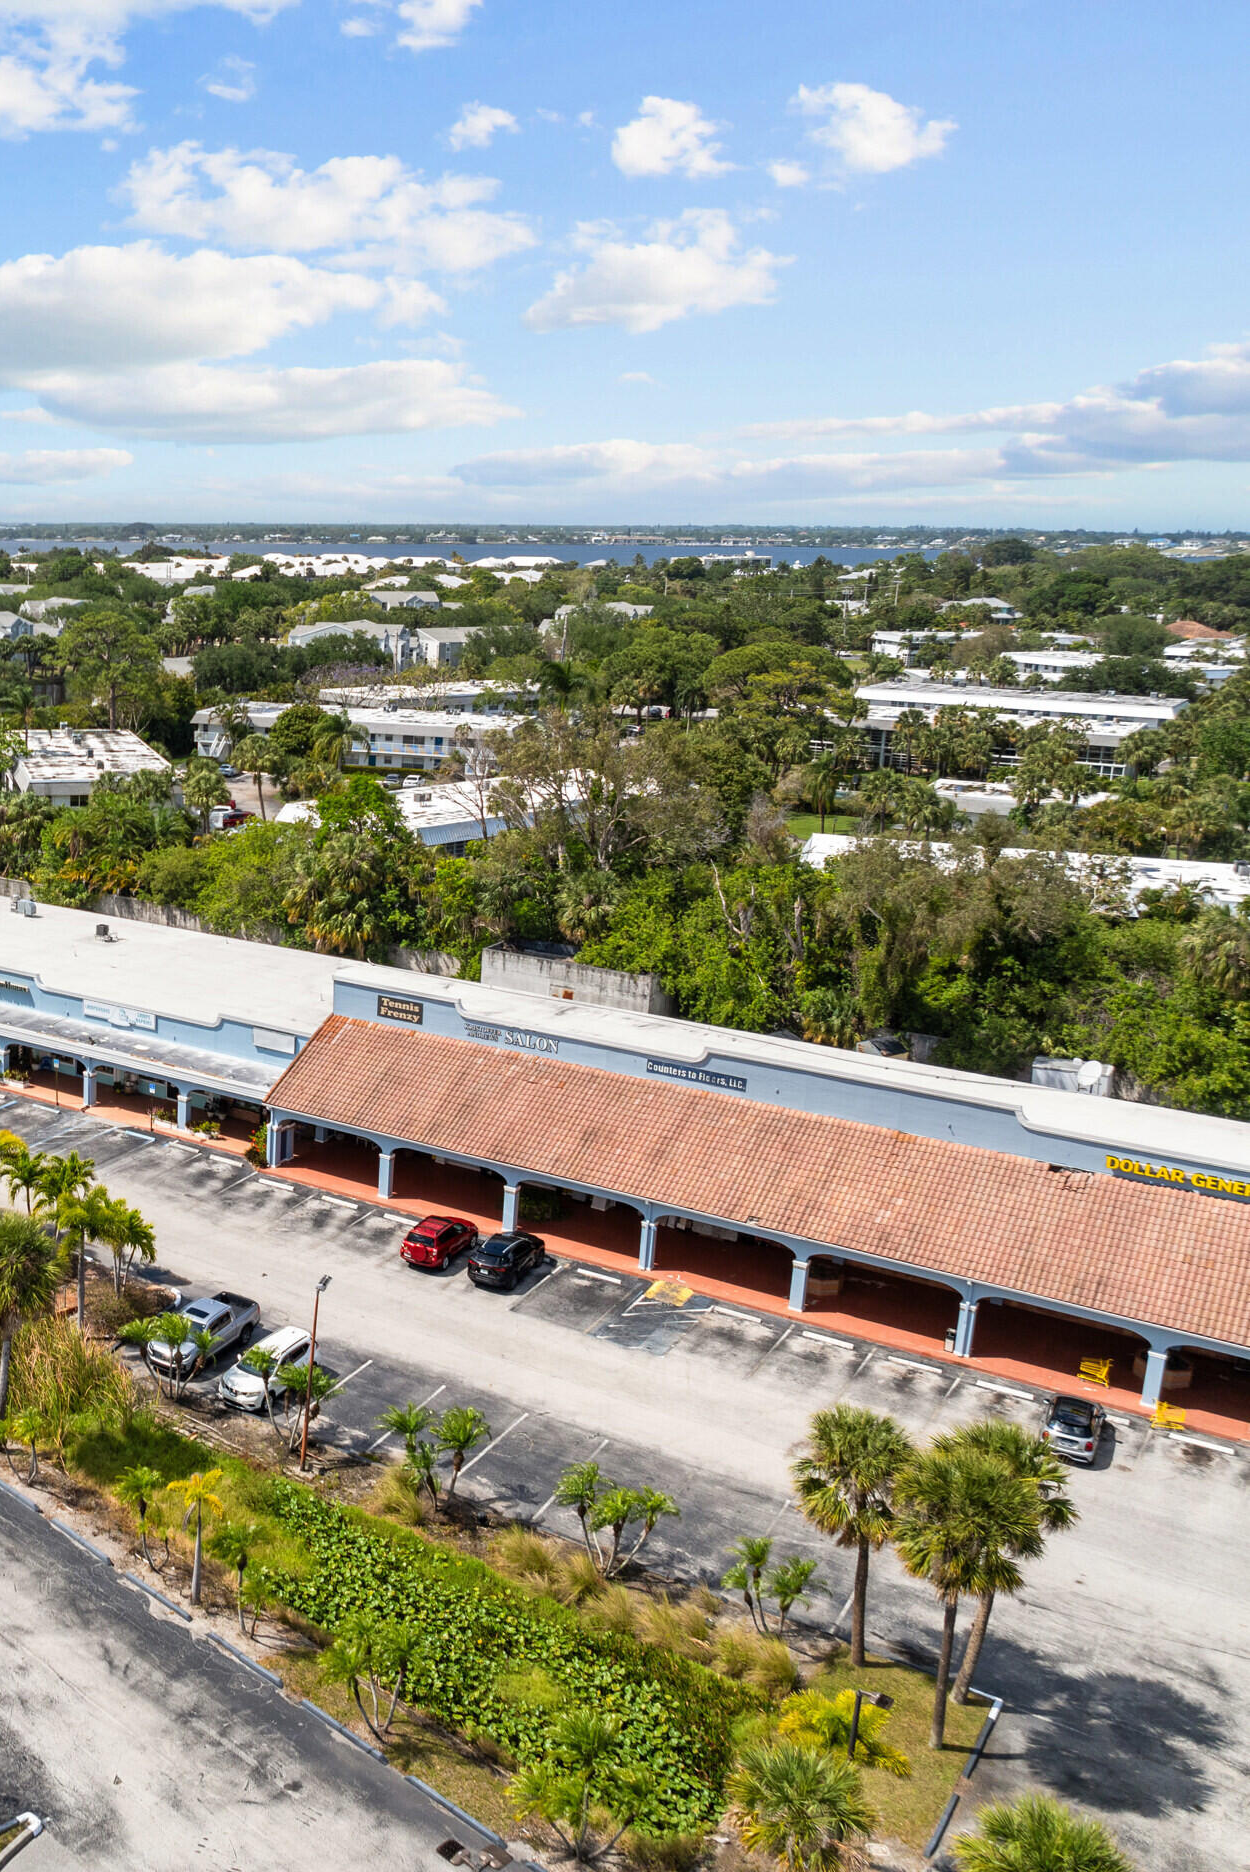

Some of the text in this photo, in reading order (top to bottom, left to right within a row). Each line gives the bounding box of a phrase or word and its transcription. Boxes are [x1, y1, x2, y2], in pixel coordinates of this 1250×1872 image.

[381, 997, 420, 1012] Tennis
[380, 1006, 420, 1022] Frenzy
[505, 1031, 560, 1054] SALON
[647, 1062, 687, 1077] Counters
[688, 1070, 697, 1080] to
[1105, 1155, 1185, 1184] DOLLAR
